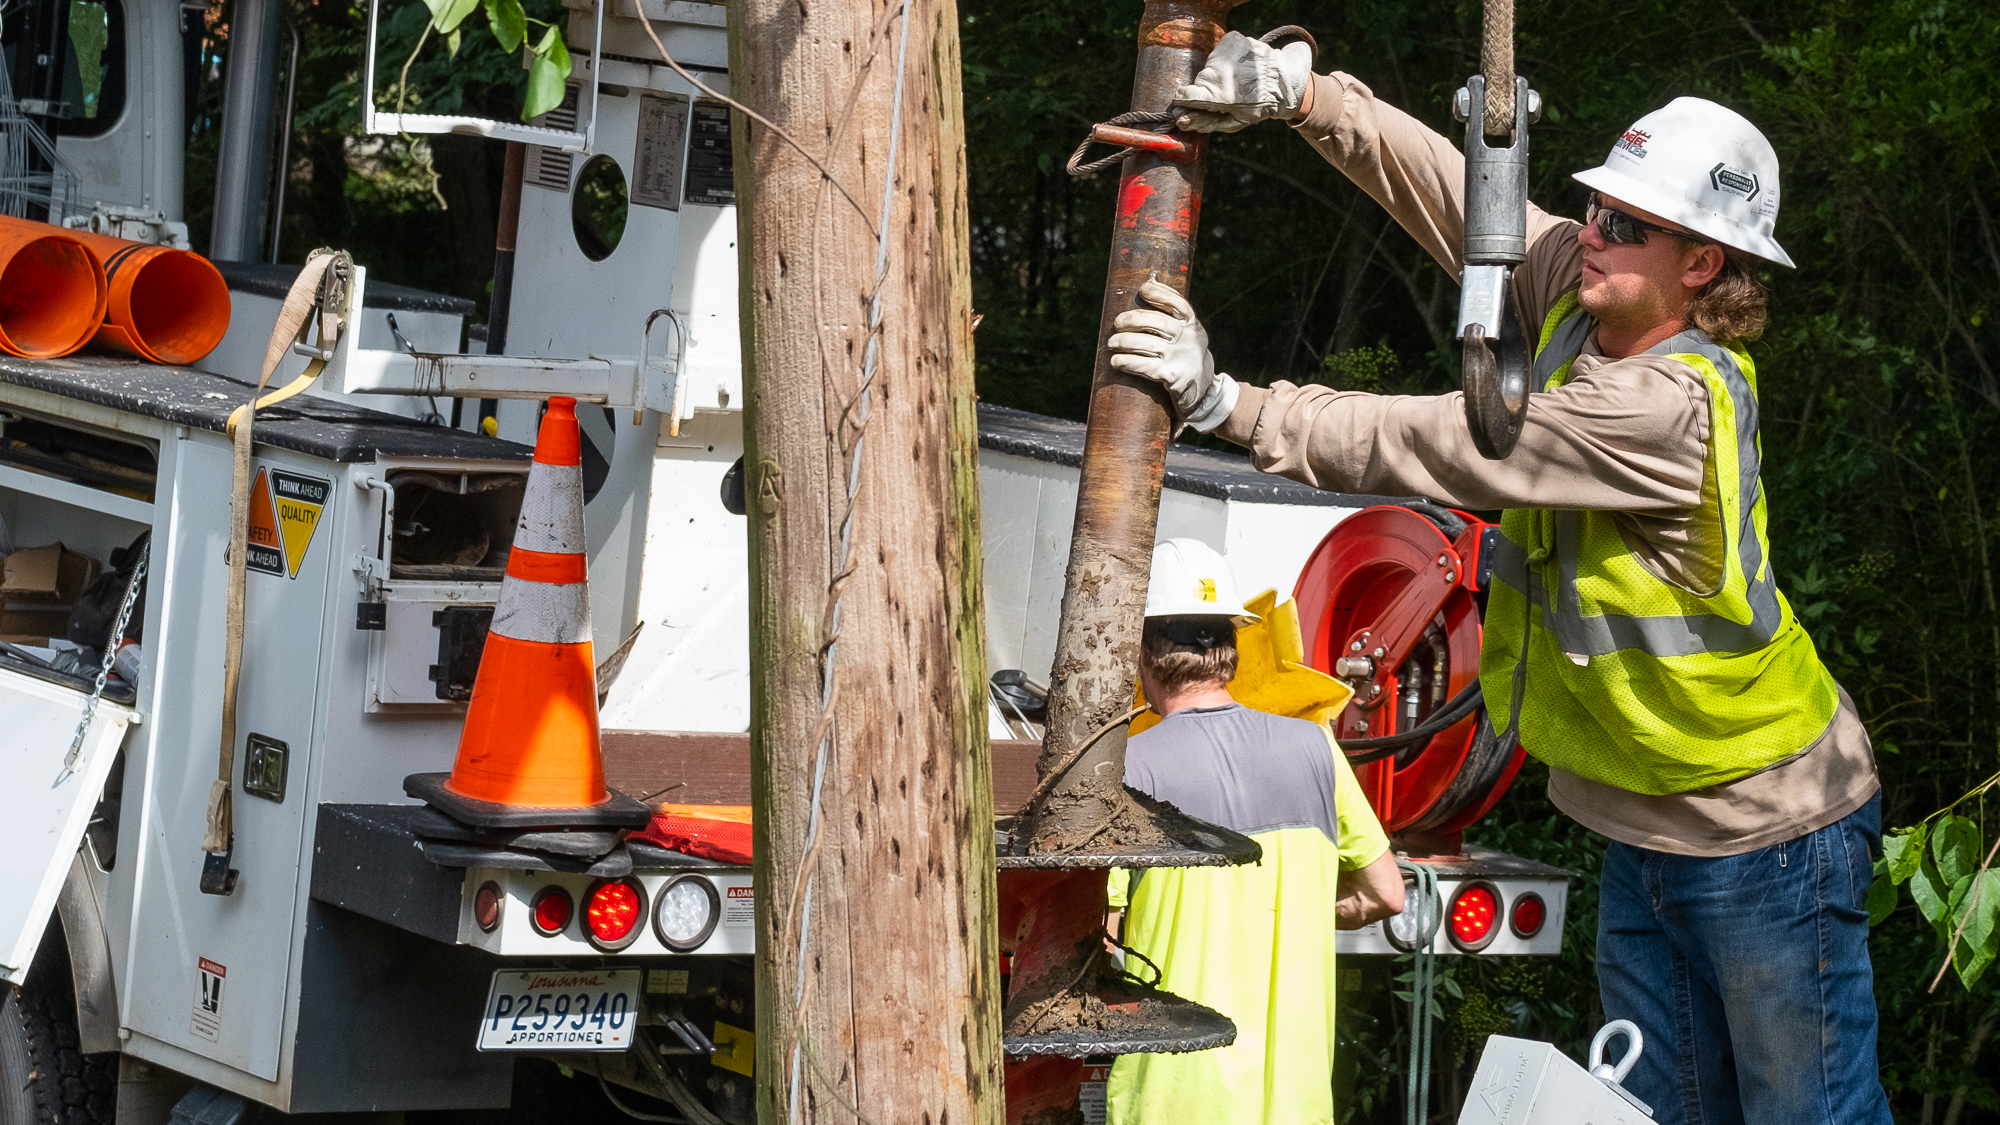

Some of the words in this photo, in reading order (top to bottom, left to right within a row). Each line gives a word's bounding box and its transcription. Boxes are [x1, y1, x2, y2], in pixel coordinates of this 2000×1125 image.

[278, 479, 300, 494] THINK
[300, 483, 323, 499] AHEAD
[281, 504, 316, 524] QUALITY
[247, 526, 274, 542] AFETY
[255, 551, 278, 567] AHEAD
[736, 888, 754, 898] DAN
[528, 974, 604, 991] Louisiana
[491, 992, 628, 1031] P259340
[511, 1031, 603, 1043] APPORTIONED
